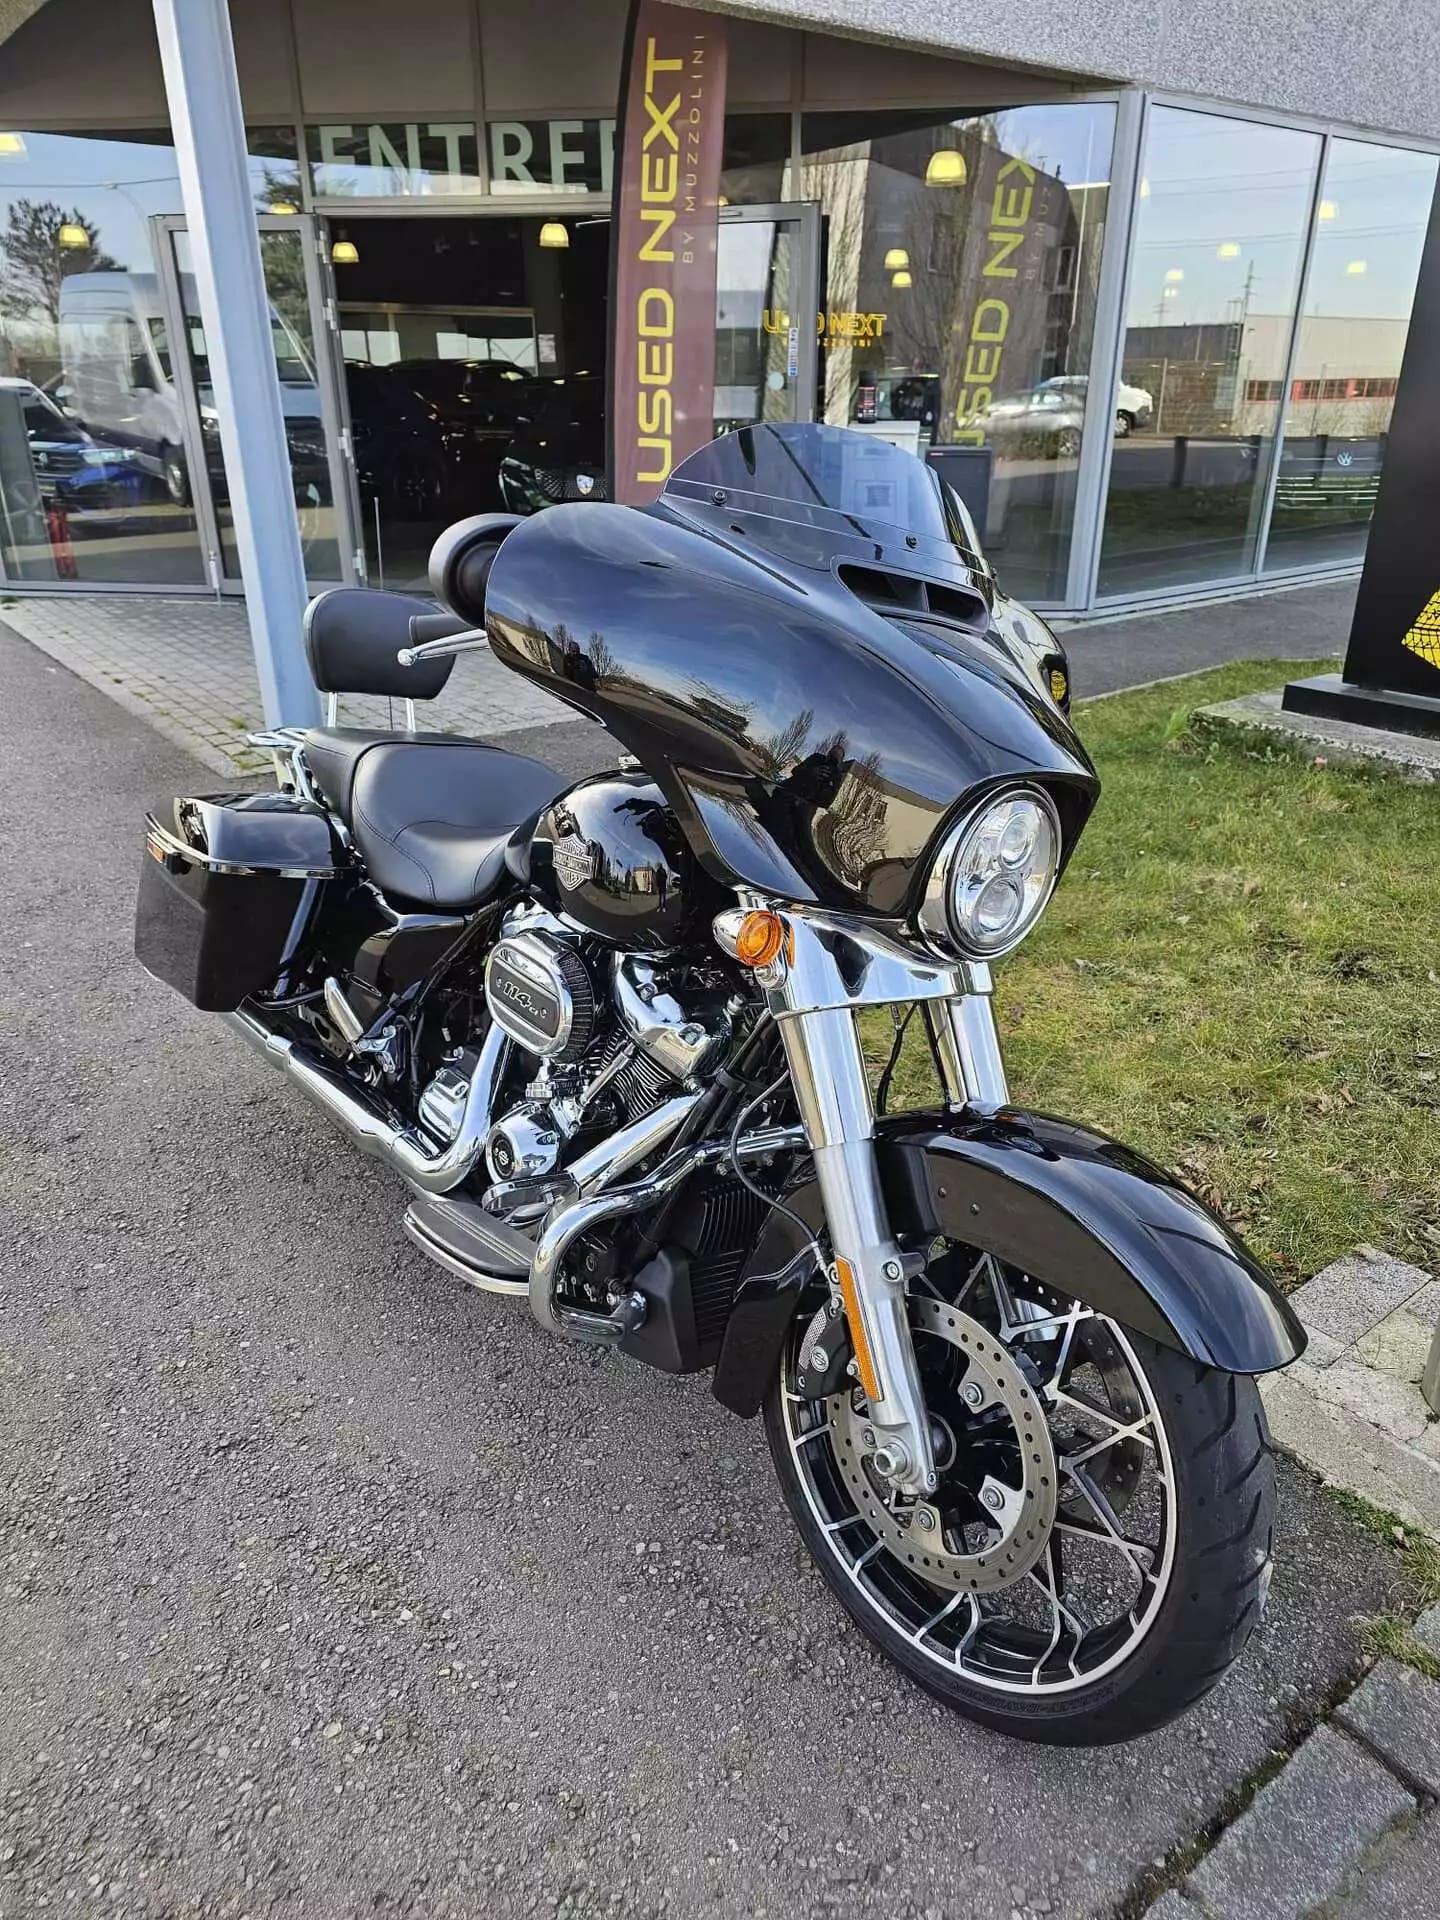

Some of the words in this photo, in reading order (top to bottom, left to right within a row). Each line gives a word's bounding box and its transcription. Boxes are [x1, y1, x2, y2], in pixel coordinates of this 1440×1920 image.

[638, 37, 683, 263] NEXT
[685, 35, 705, 212] MUZZOLINI
[682, 231, 695, 264] BY
[829, 311, 888, 337] NEXT
[637, 287, 675, 483] USED
